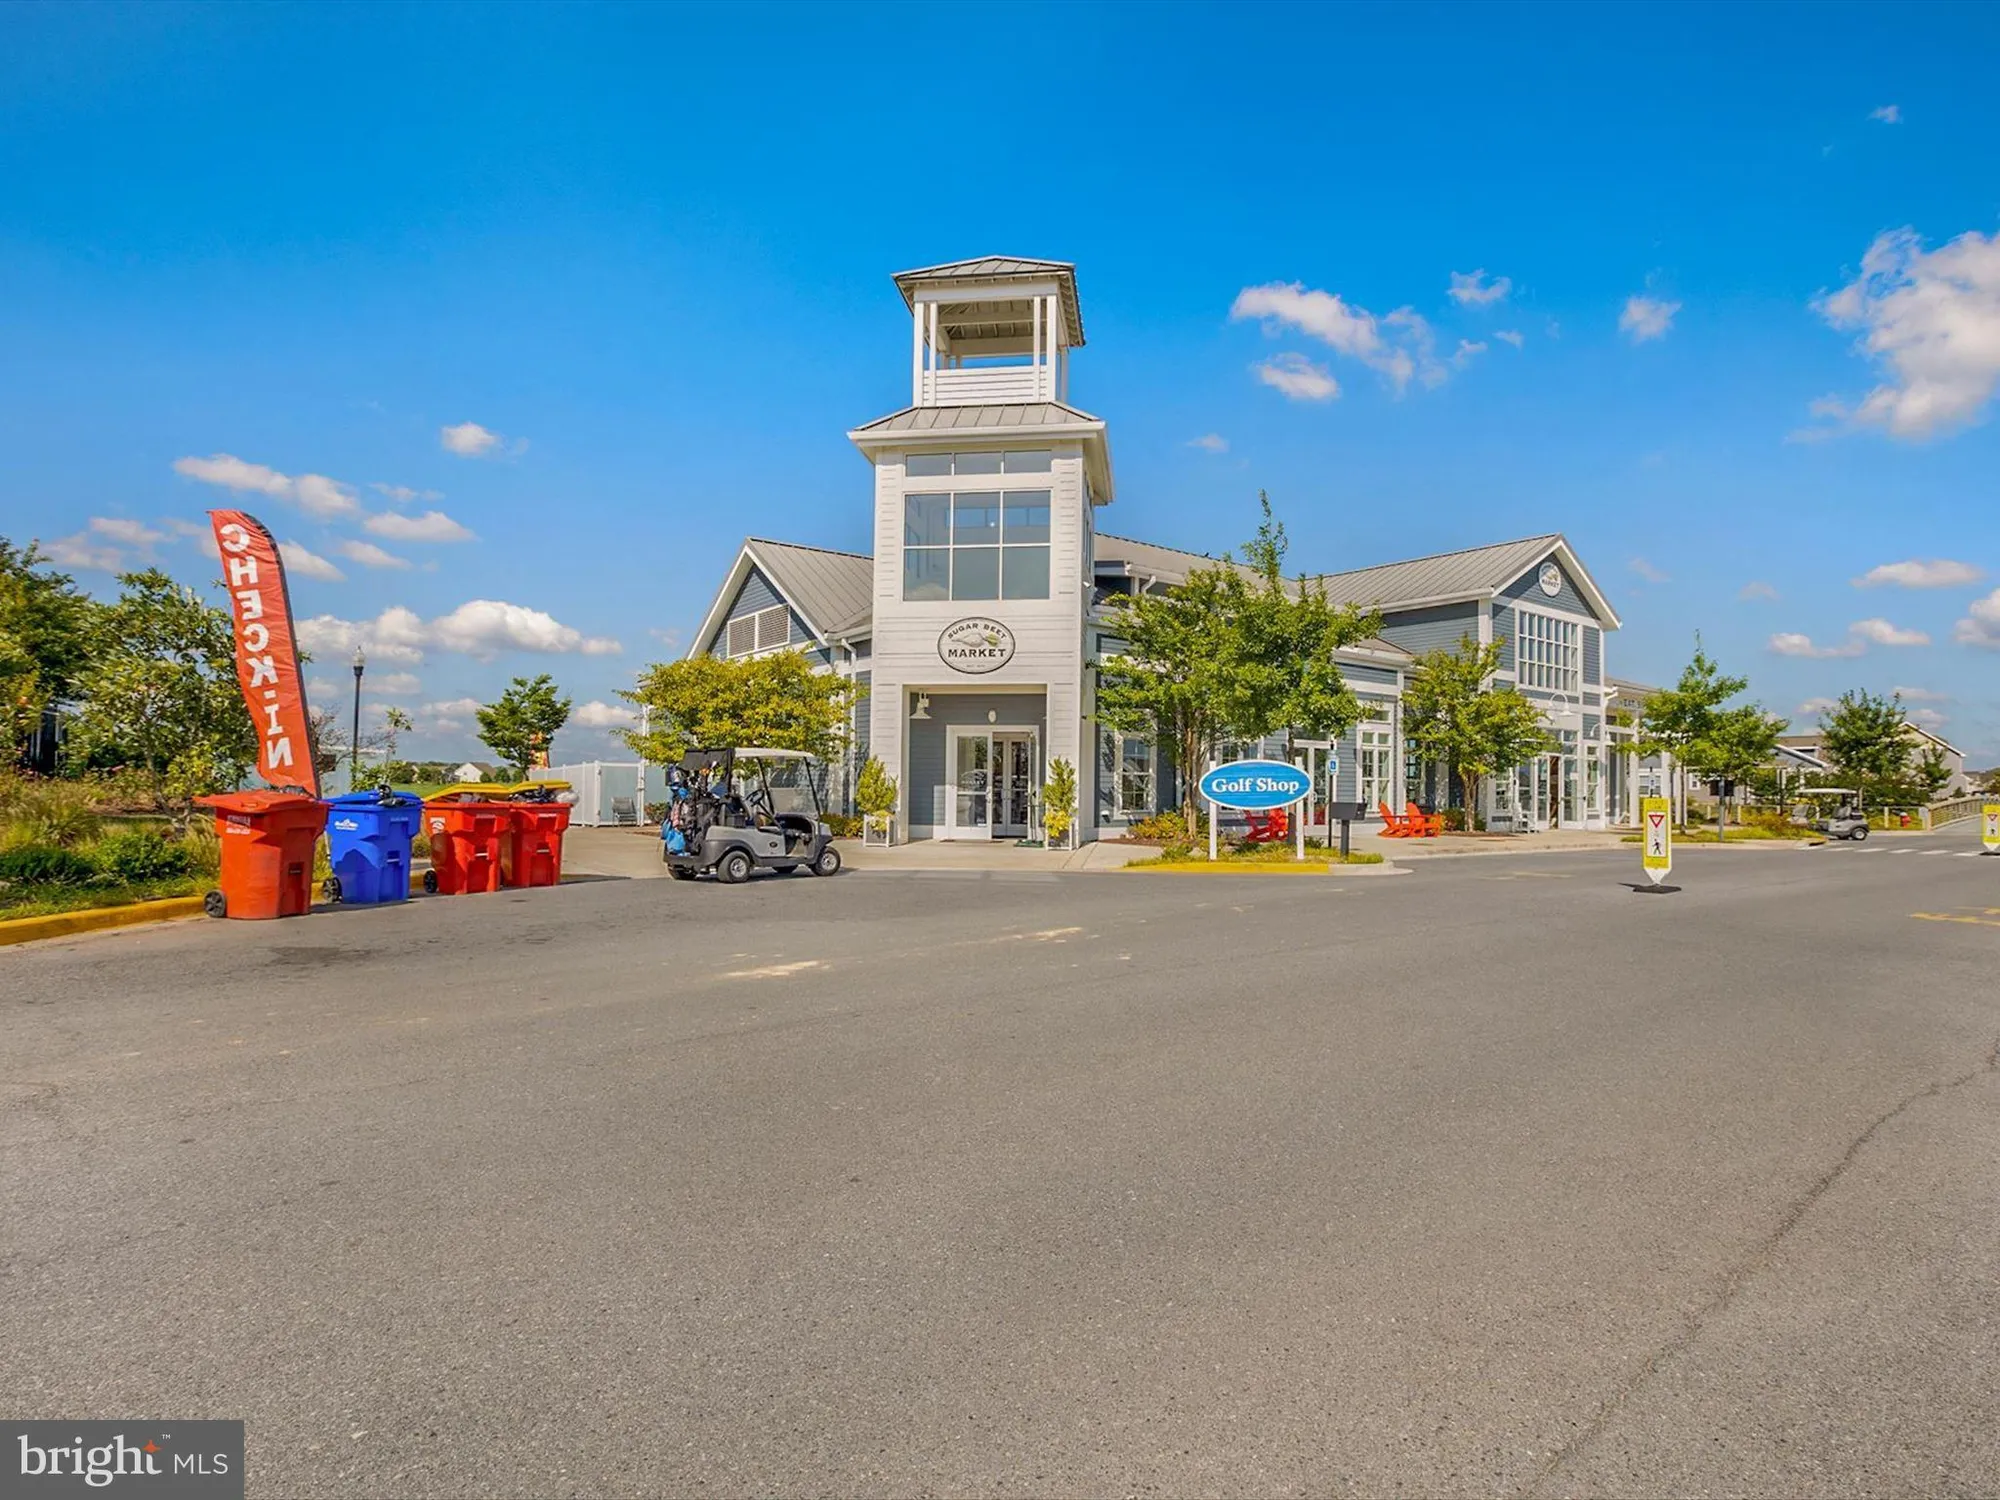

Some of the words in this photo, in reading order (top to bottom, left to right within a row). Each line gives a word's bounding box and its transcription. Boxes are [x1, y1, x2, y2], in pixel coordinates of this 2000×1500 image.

[948, 623, 979, 640] SUGAR
[983, 623, 1007, 640] BEET
[948, 648, 1007, 658] MARKET
[1211, 777, 1253, 793] Golf
[1256, 777, 1299, 795] Shop
